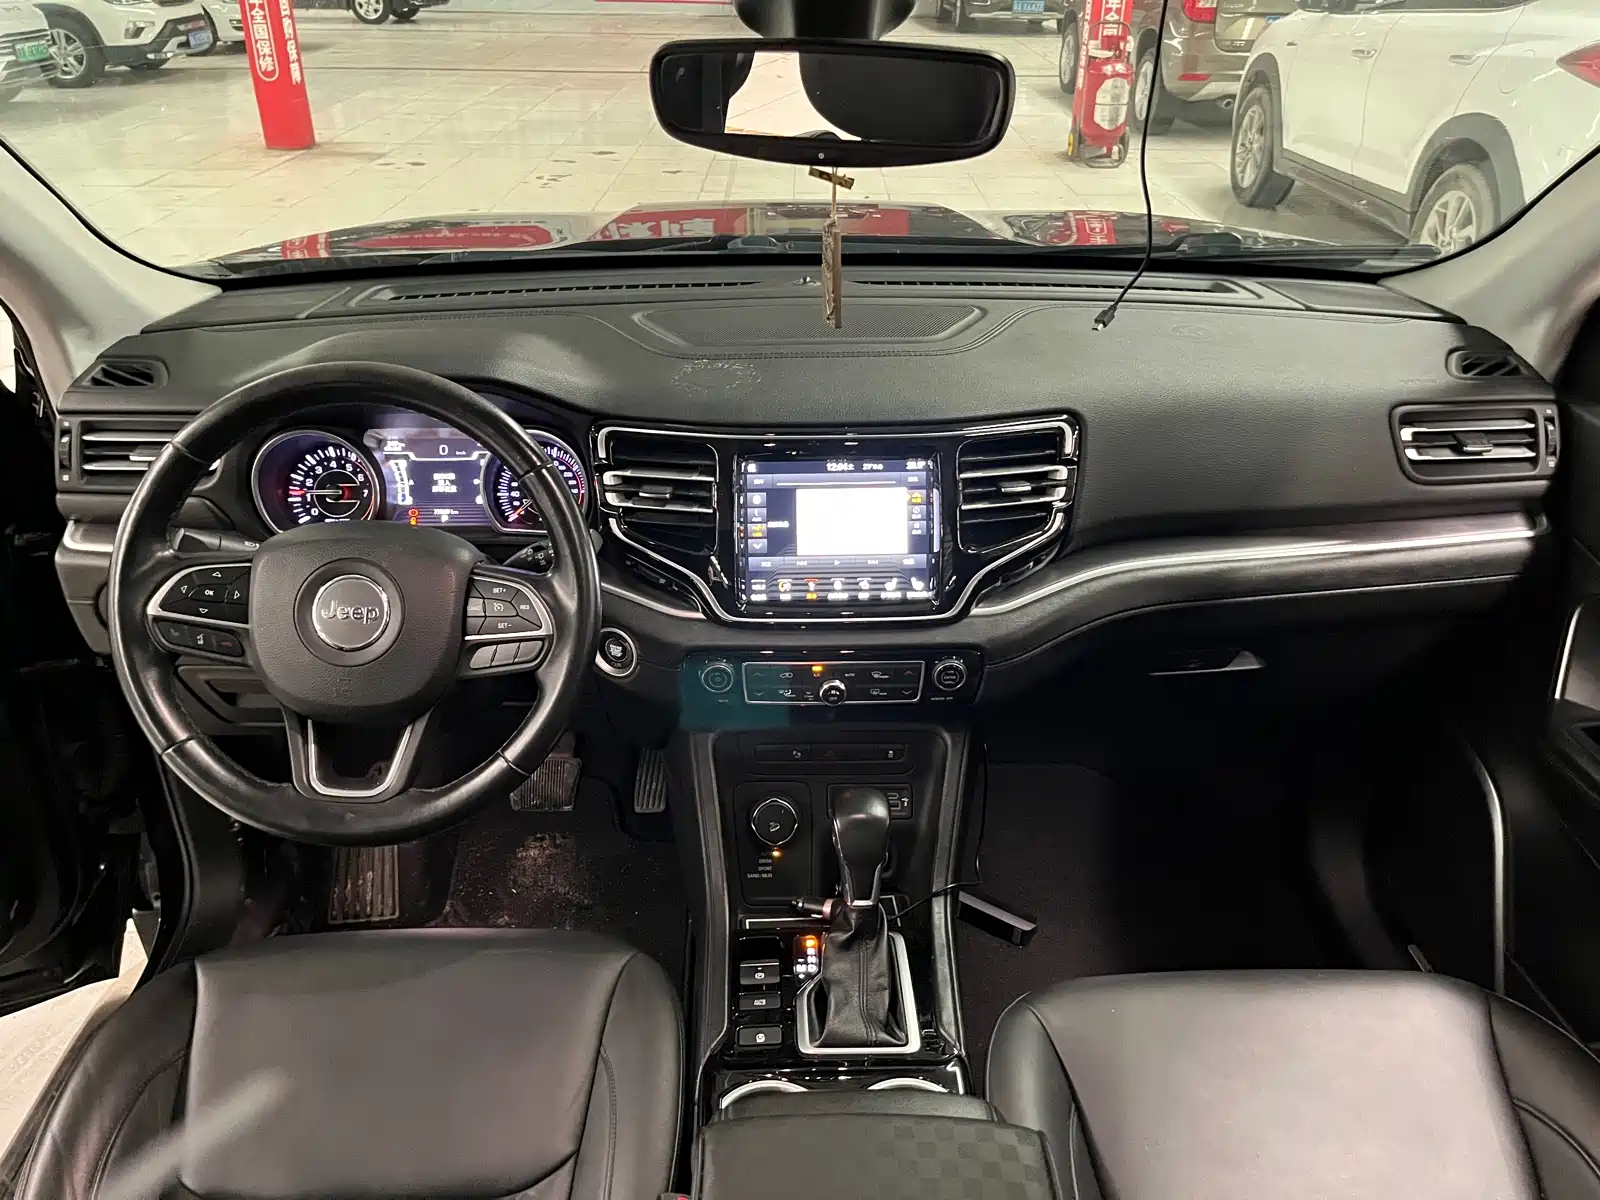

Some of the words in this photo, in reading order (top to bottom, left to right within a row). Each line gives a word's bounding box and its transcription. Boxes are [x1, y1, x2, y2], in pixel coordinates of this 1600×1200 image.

[438, 444, 449, 456] 0
[329, 460, 338, 469] 4
[345, 463, 354, 472] 5
[314, 466, 323, 475] 3
[357, 473, 365, 482] 6
[305, 478, 314, 487] 2
[305, 492, 312, 502] 1
[362, 489, 369, 498] 7
[310, 507, 320, 516] 0
[321, 600, 380, 625] Jeep
